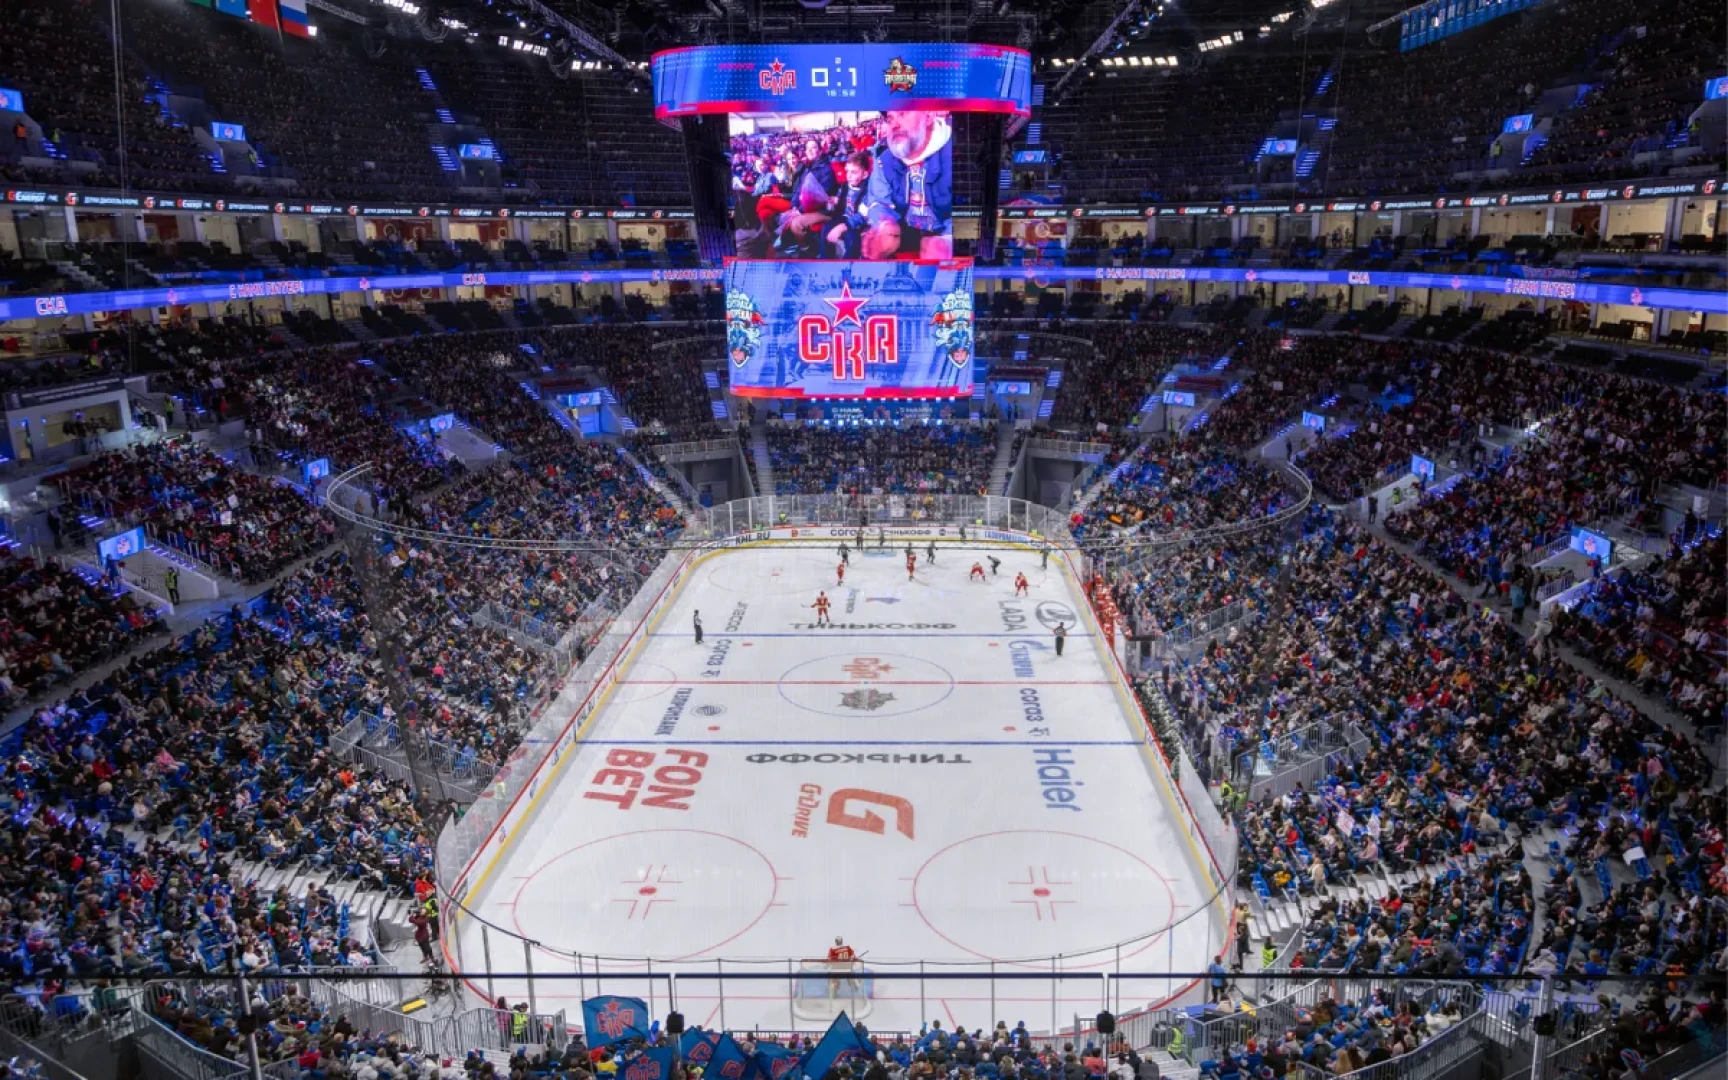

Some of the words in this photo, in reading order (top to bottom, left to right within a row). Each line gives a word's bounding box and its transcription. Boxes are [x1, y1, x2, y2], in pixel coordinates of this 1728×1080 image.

[36, 296, 68, 316] СКА
[798, 314, 898, 380] СКА
[788, 622, 957, 630] ТИНЬКОФФ
[998, 600, 1028, 632] LADA
[583, 748, 657, 810] BET
[640, 748, 709, 811] FON
[745, 753, 972, 764] ТИНЬКОФФ
[1032, 749, 1085, 812] Haier
